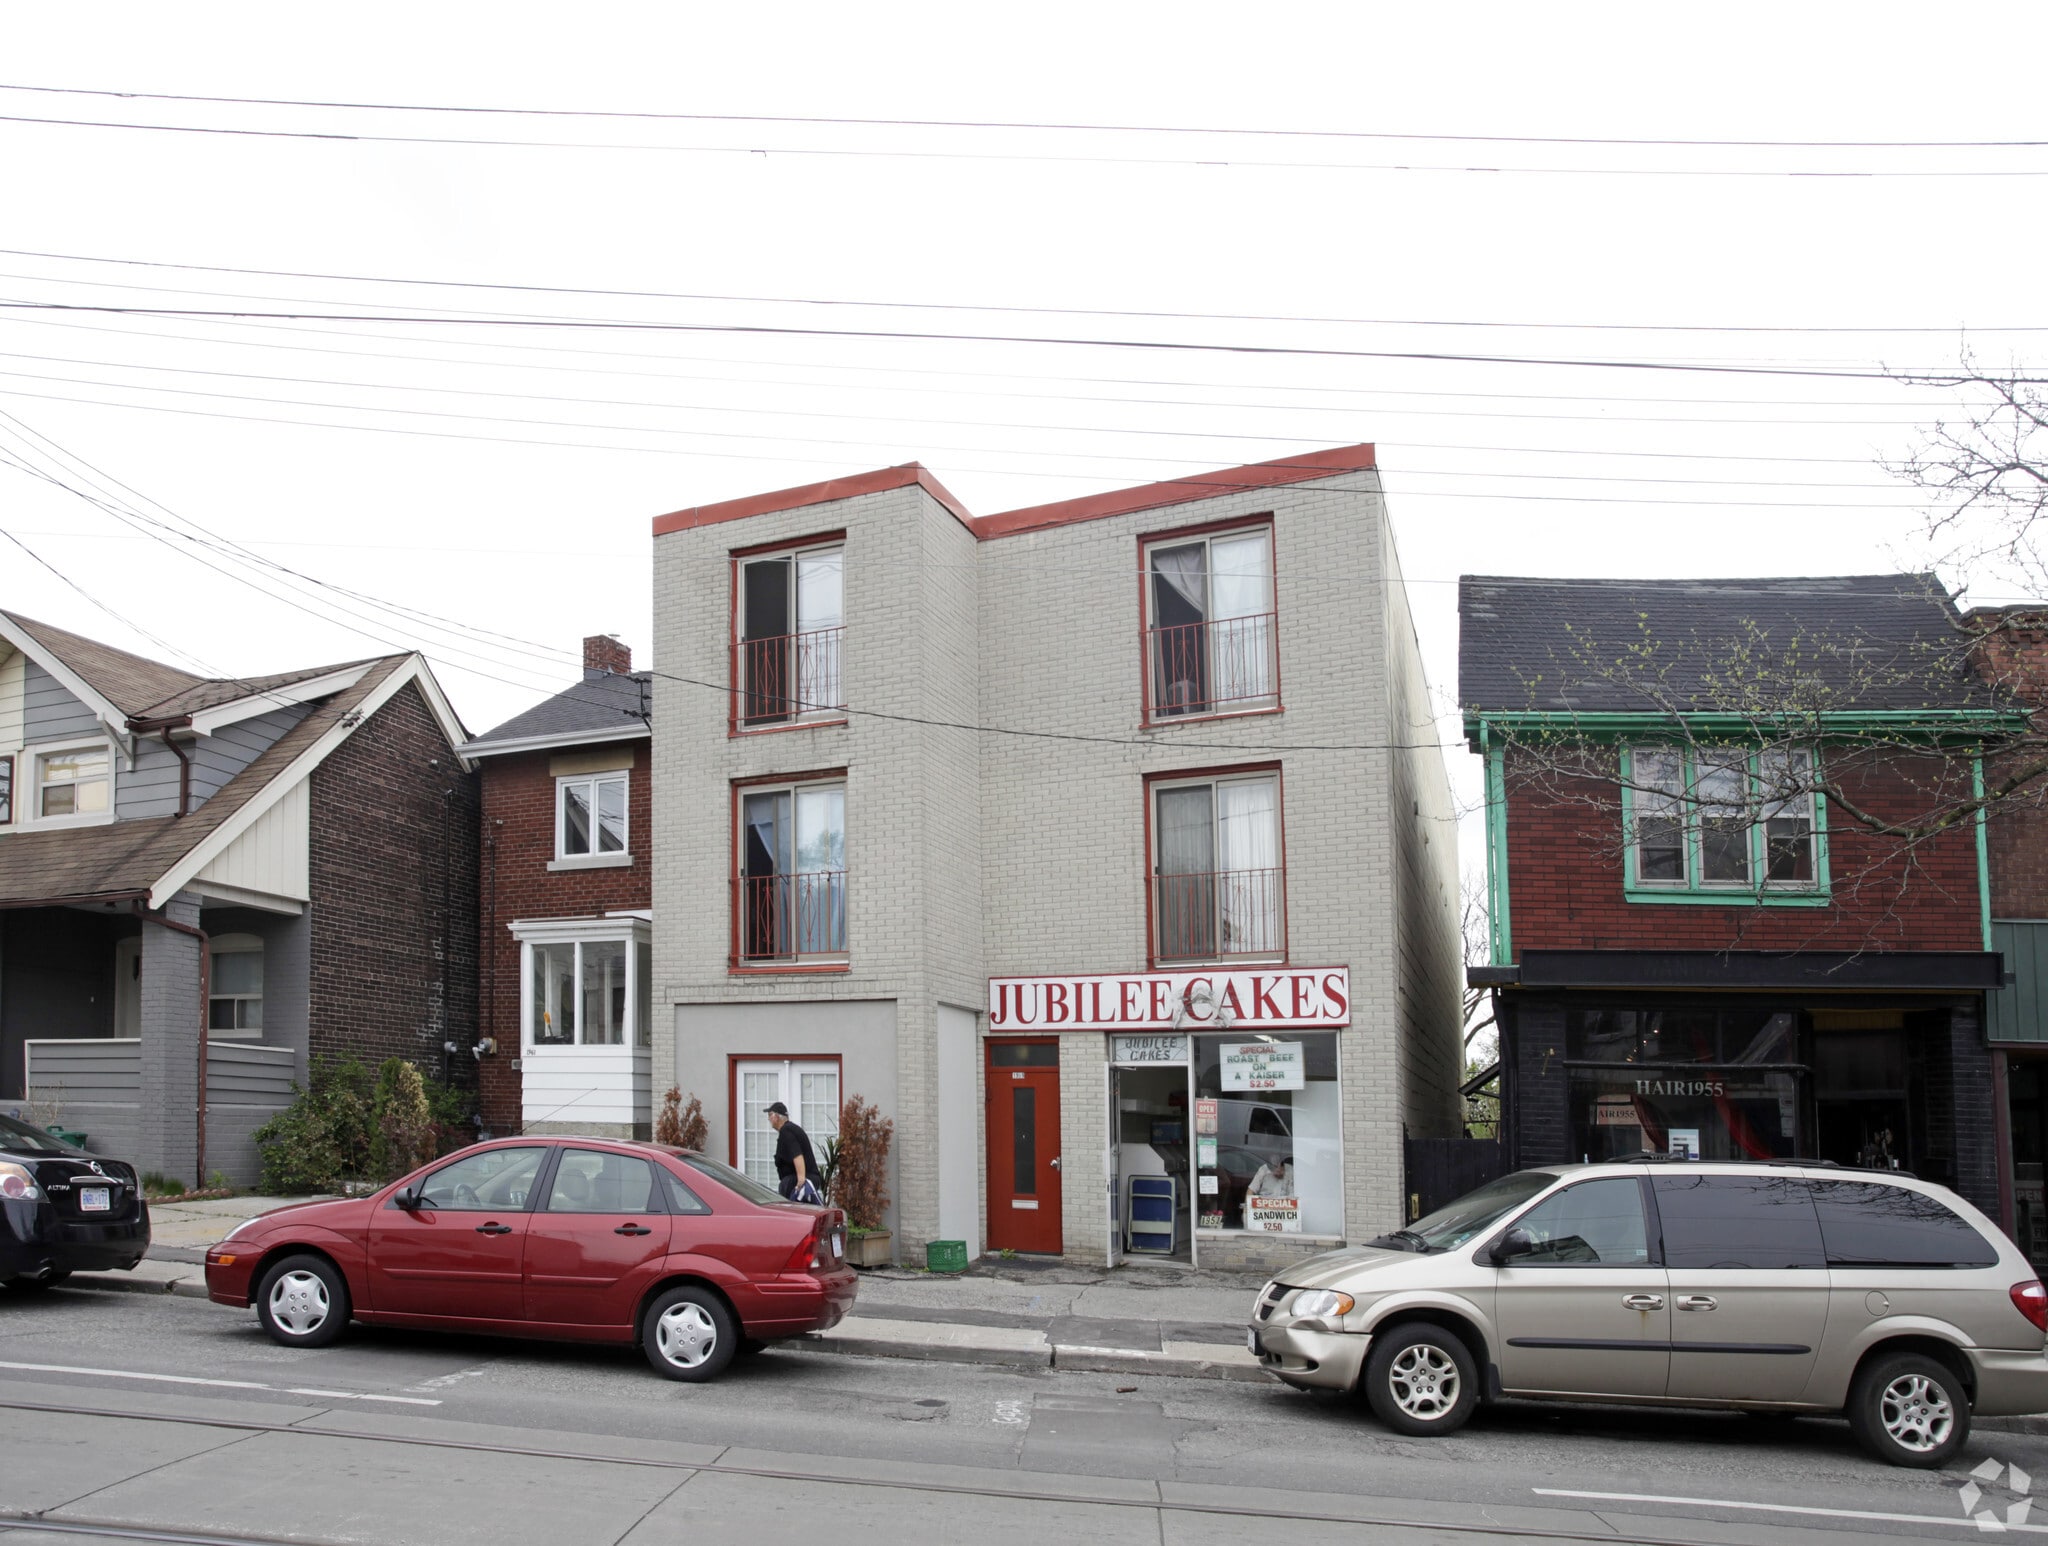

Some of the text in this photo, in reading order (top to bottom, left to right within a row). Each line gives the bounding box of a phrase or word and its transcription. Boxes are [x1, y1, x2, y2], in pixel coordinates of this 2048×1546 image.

[990, 973, 1347, 1024] JUBILEE CAKES
[1125, 1037, 1177, 1049] JUBILEE
[1130, 1050, 1170, 1060] CAKES
[1239, 1046, 1277, 1055] SPECIAL
[1227, 1054, 1294, 1063] ROAST BEEF
[1252, 1063, 1267, 1071] ON
[1235, 1071, 1285, 1080] A KAISER
[1250, 1080, 1276, 1088] $2.50
[1636, 1080, 1724, 1097] HAIR1955
[1199, 1105, 1215, 1113] OPEN
[1599, 1110, 1635, 1118] AIR1955
[2016, 1189, 2043, 1201] PEN
[1256, 1199, 1294, 1208] SPECIAL
[1264, 1222, 1283, 1231] $2.50
